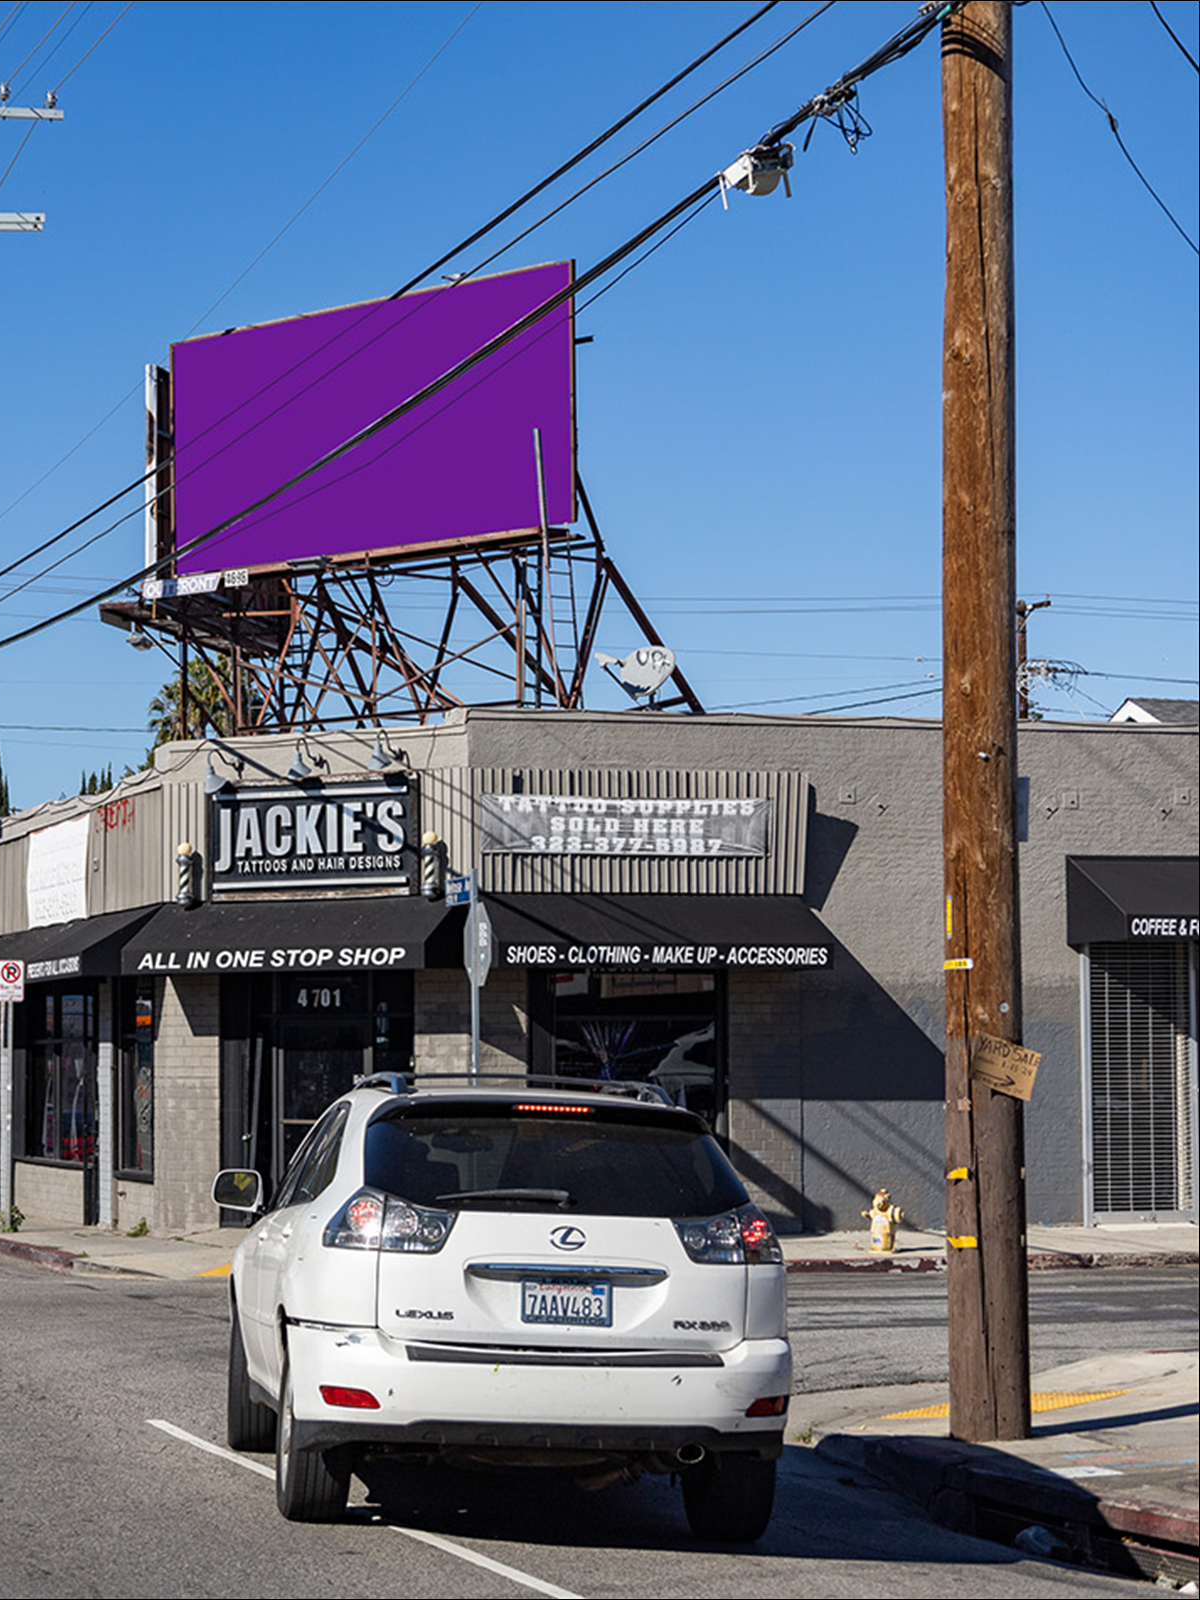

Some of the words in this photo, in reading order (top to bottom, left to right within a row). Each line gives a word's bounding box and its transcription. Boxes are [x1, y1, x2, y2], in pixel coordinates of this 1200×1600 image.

[499, 798, 607, 813] TATTOO
[621, 799, 755, 815] SUPPLIES
[550, 817, 619, 833] SOLD
[633, 818, 705, 834] HERE
[214, 800, 404, 872] JACKIE'S
[237, 860, 287, 874] TATTOOS
[291, 858, 315, 872] AND
[318, 857, 345, 871] HAIR
[350, 855, 401, 869] DESIGNS
[1131, 917, 1177, 935] COFFEE
[1178, 918, 1187, 936] &
[137, 953, 181, 970] ALL
[186, 951, 210, 969] IN
[215, 950, 265, 968] ONE
[270, 949, 333, 967] STOP
[338, 948, 406, 966] SHOP
[506, 945, 556, 963] SHOES
[568, 945, 641, 964] CLOTHING
[652, 946, 694, 964] MAKE
[697, 946, 718, 964] UP
[726, 946, 828, 965] ACCESSORIES
[297, 989, 341, 1007] 4701
[979, 1036, 1011, 1058] YARD
[1012, 1046, 1041, 1067] SALE
[395, 1309, 454, 1320] LEXUS
[528, 1294, 603, 1318] 7AAV483
